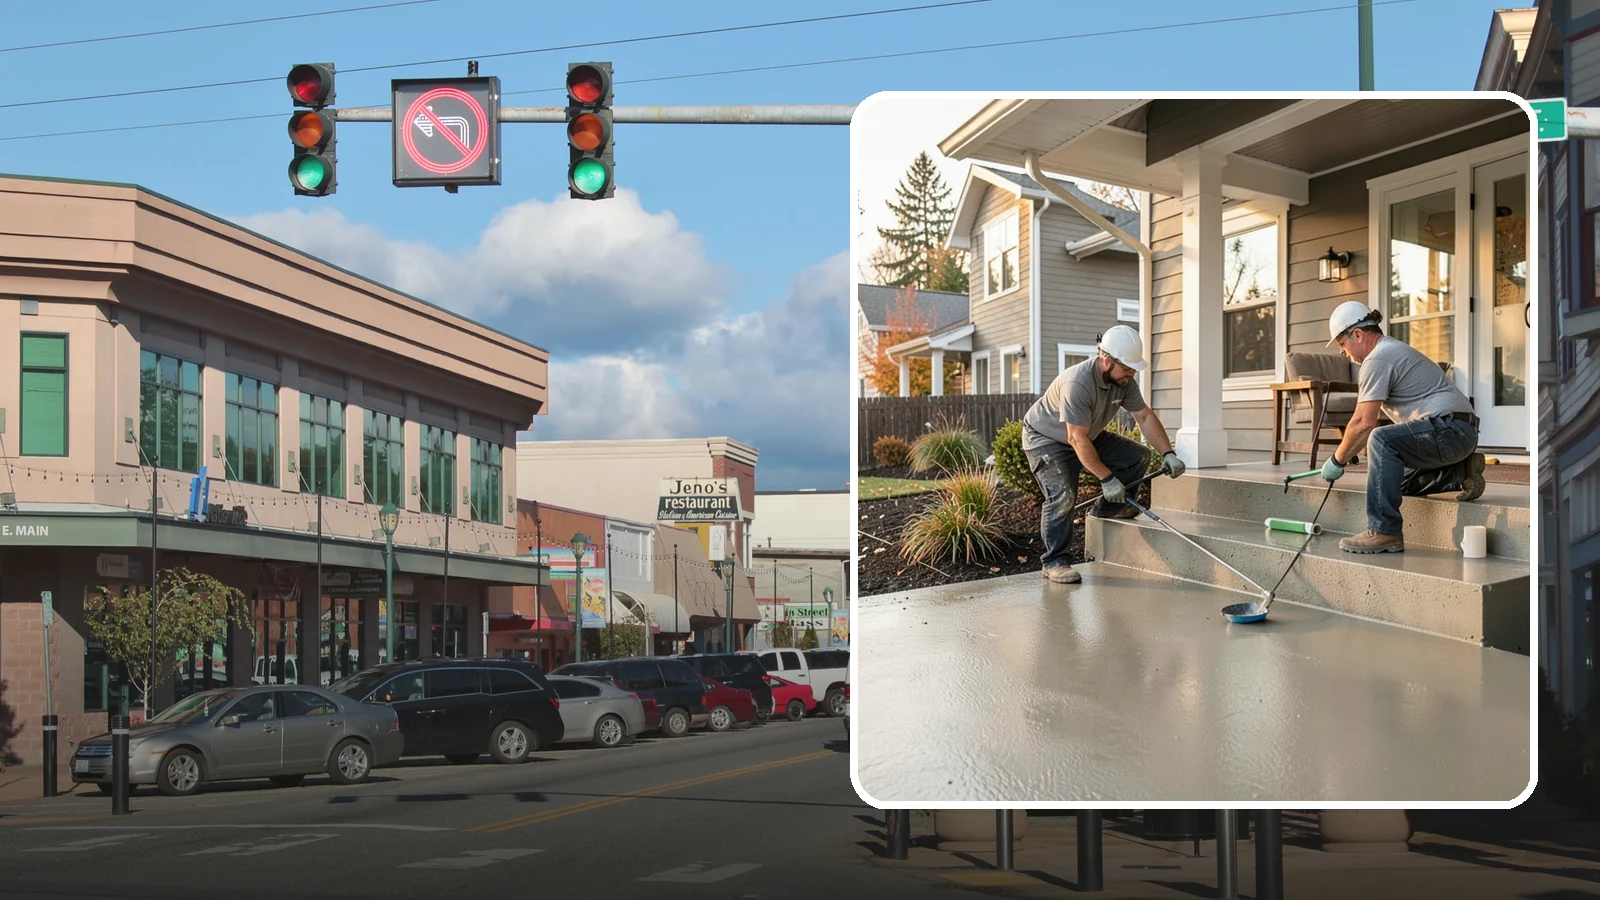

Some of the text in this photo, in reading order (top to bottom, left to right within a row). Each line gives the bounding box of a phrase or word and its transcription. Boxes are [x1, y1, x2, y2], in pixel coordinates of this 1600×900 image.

[669, 480, 727, 495] Jeno's
[665, 496, 731, 509] restaurant
[659, 510, 681, 519] Italian
[686, 510, 714, 519] American
[715, 509, 737, 519] Cuisine
[2, 525, 49, 536] E. MAIN
[797, 607, 828, 617] Street
